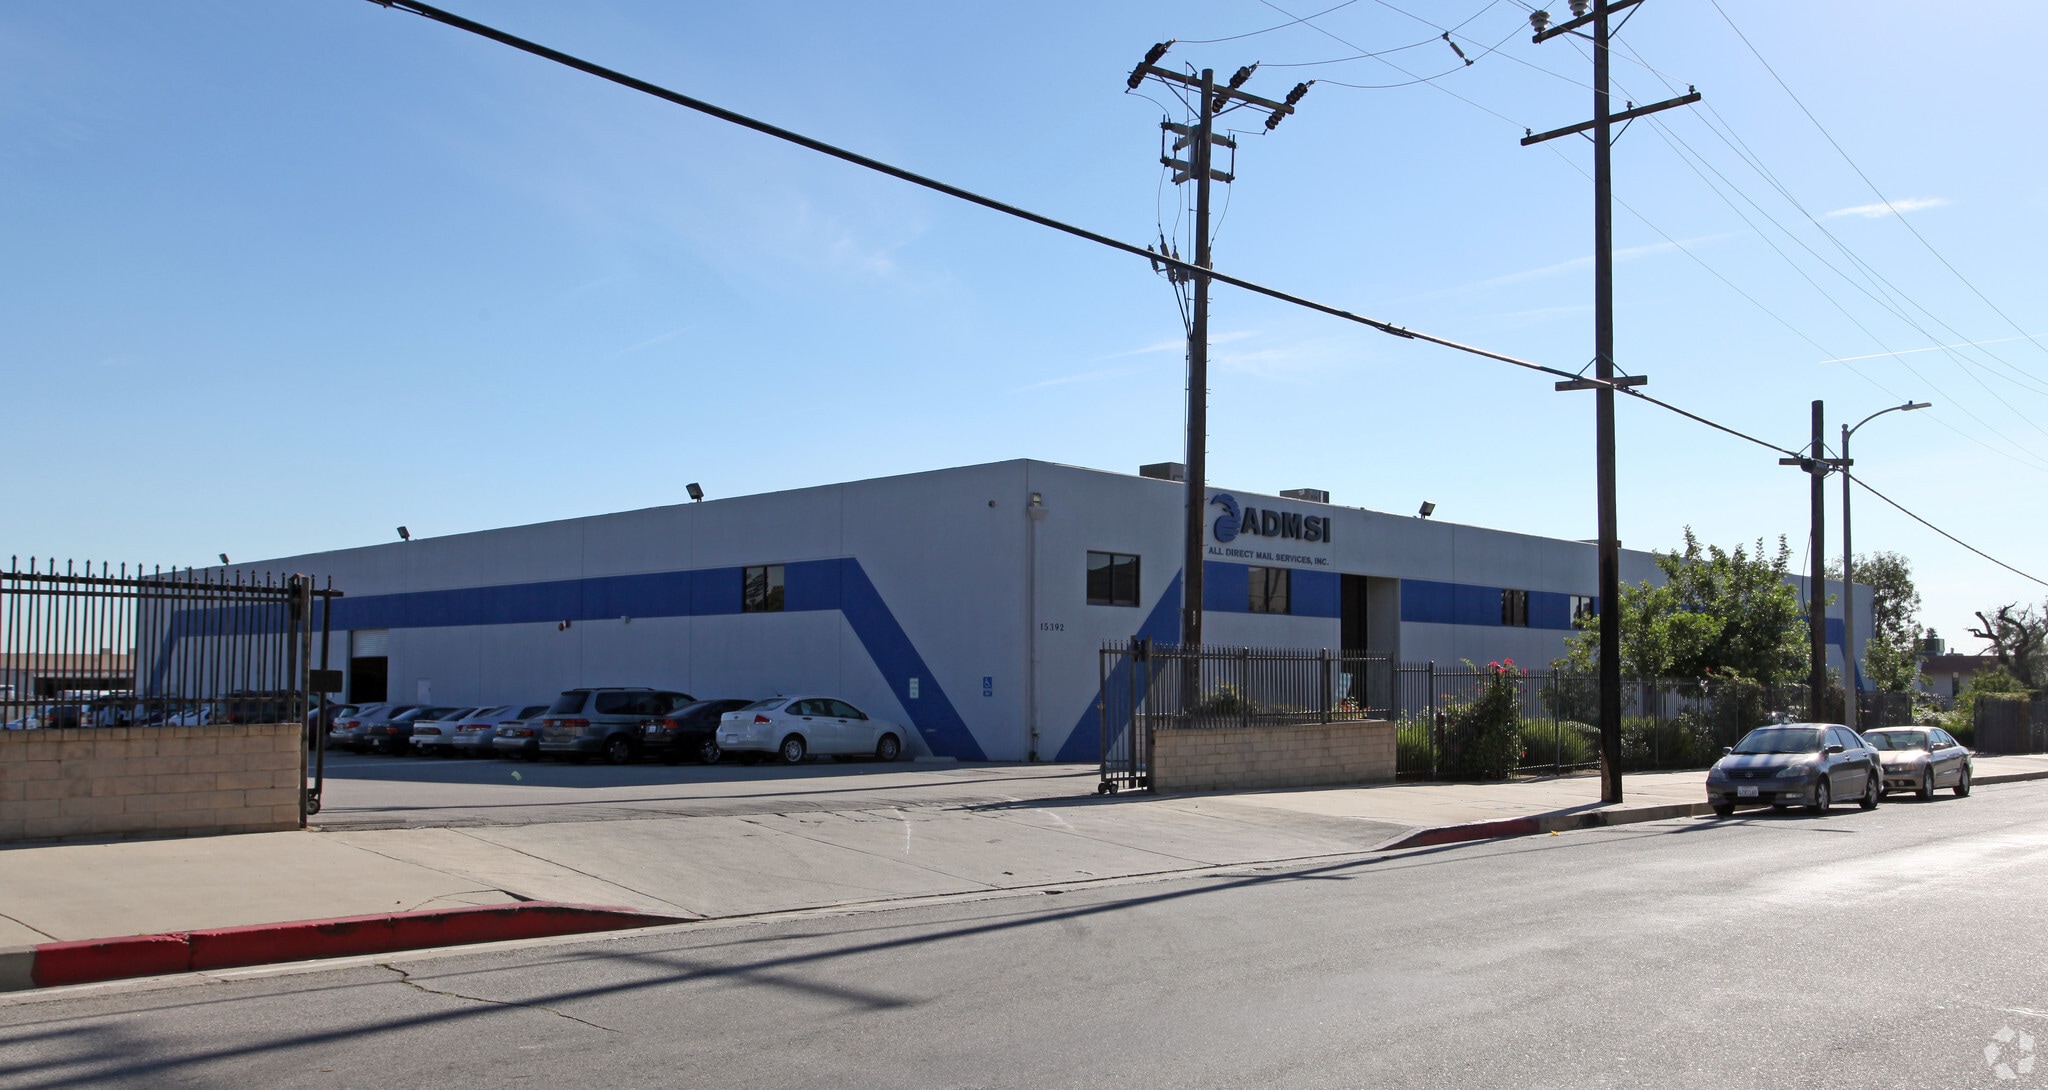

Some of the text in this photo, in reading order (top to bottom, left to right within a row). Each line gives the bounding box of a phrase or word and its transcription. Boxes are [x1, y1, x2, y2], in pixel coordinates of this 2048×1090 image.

[1240, 507, 1331, 543] ADMSI
[1208, 546, 1330, 567] ALL DIRECT MAIL SERVICES, INC.
[1040, 623, 1064, 631] 15392
